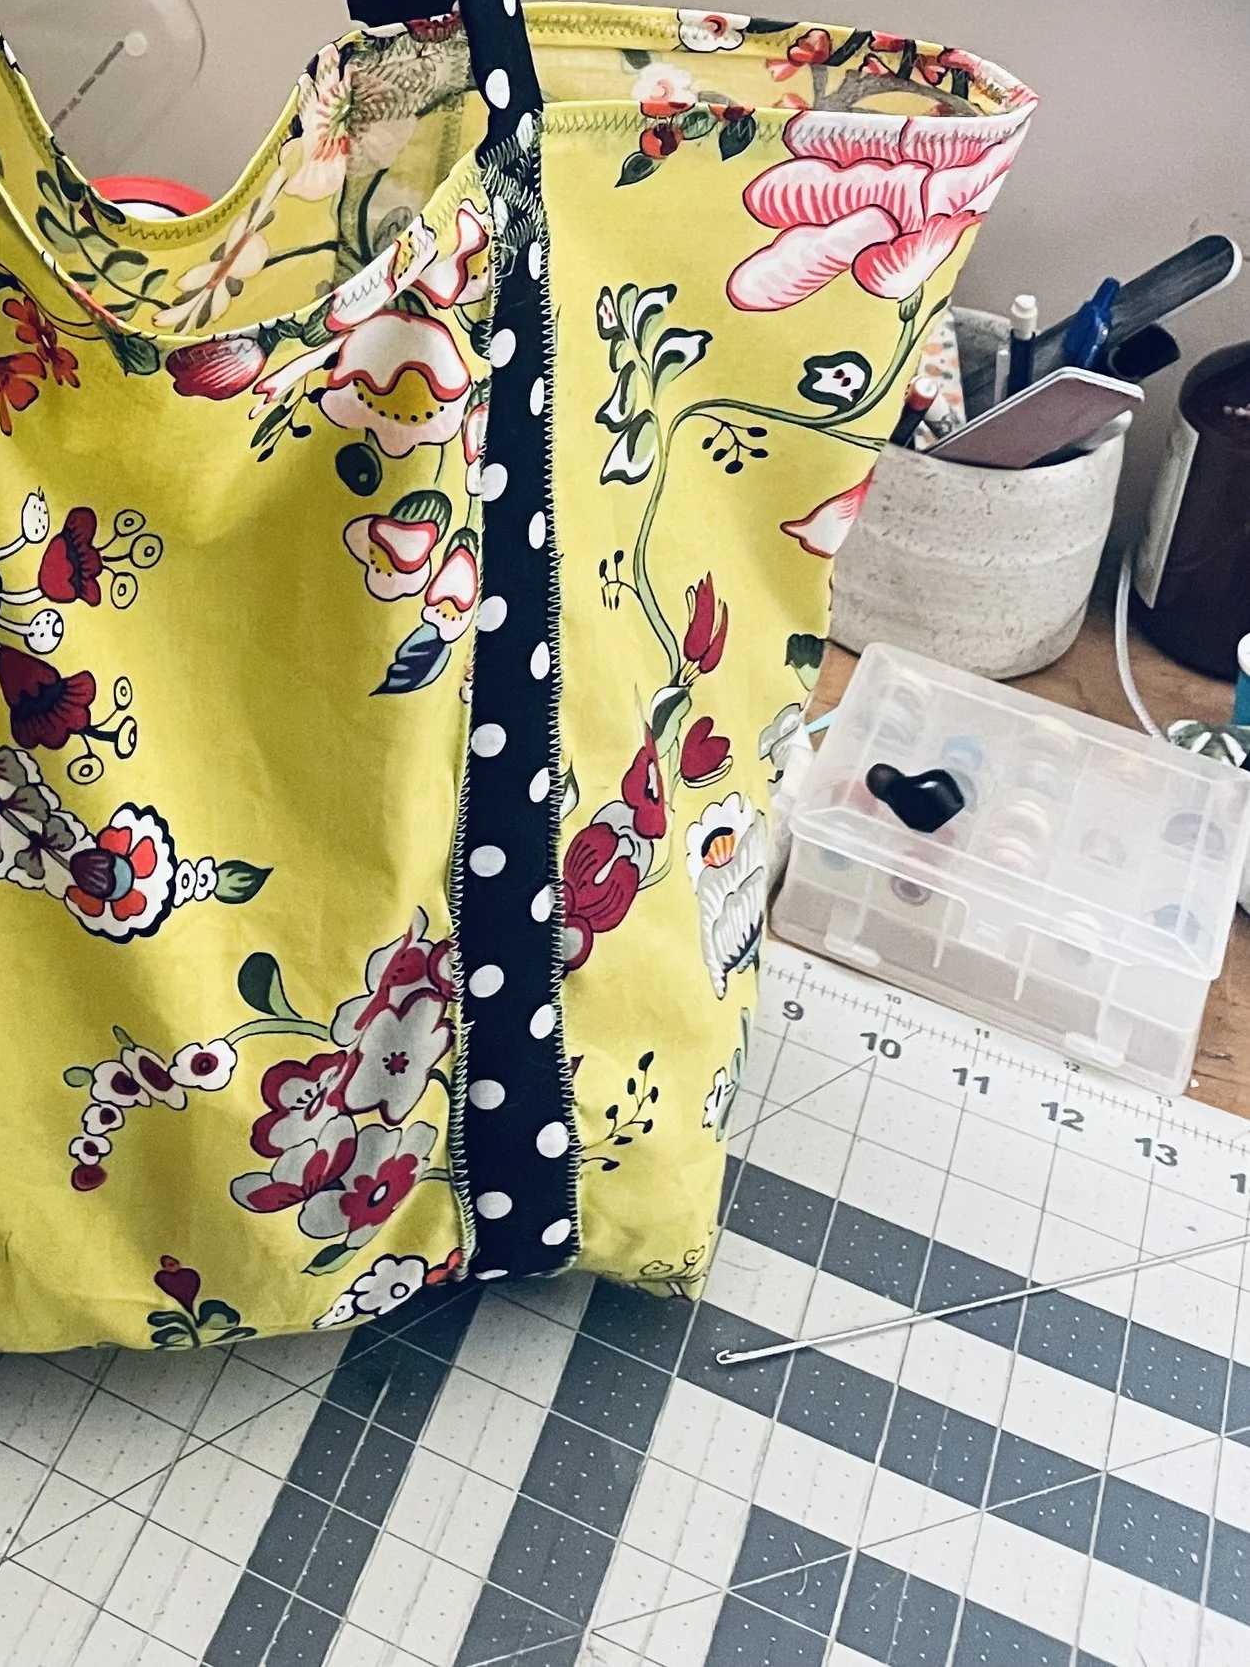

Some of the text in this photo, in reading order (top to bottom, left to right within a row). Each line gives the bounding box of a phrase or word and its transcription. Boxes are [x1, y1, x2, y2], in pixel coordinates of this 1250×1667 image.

[782, 1000, 804, 1021] 9
[885, 993, 902, 1005] 10
[860, 1032, 902, 1059] 10
[1063, 1061, 1080, 1073] 12
[952, 1067, 990, 1095] 11
[1156, 1096, 1172, 1108] 13
[1041, 1102, 1085, 1132] 12
[1134, 1137, 1178, 1167] 13
